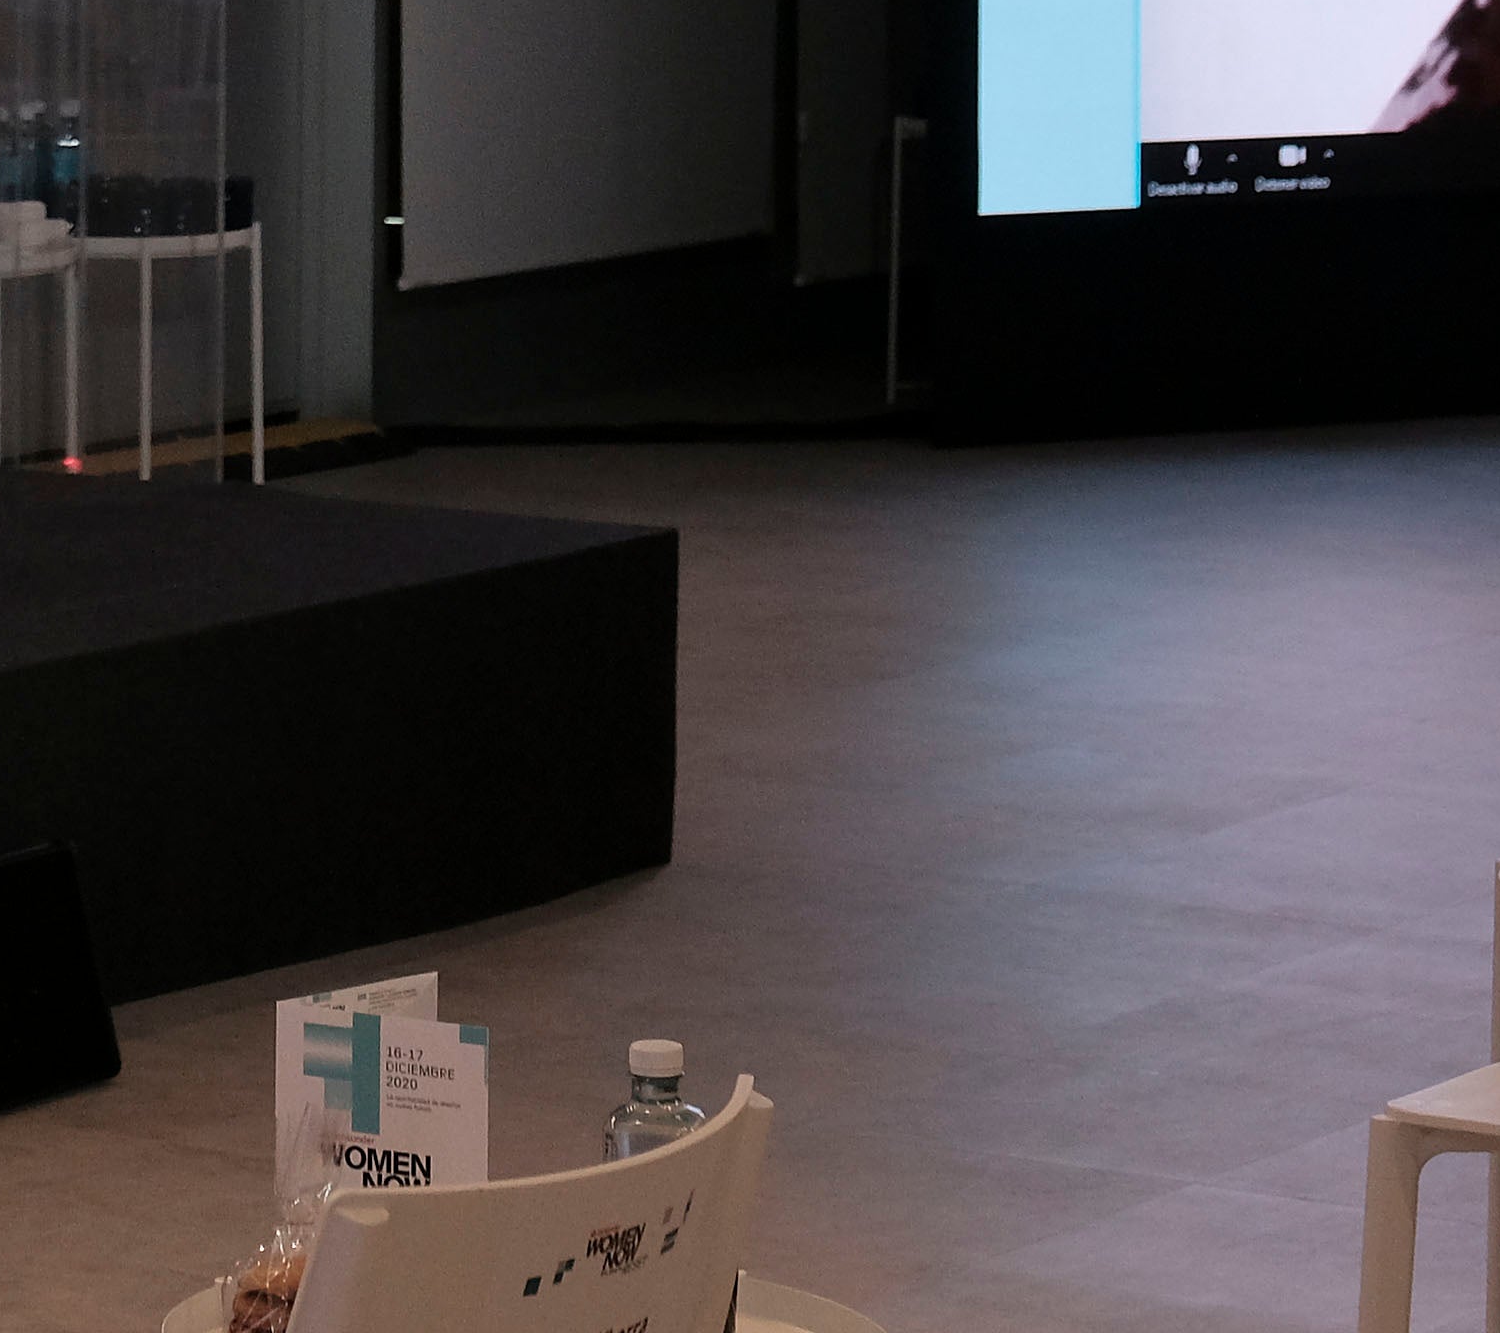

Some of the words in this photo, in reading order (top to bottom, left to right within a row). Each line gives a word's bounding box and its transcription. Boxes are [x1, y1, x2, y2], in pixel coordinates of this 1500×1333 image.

[386, 1046, 424, 1062] 16-17
[385, 1062, 455, 1081] DICIEMBRE
[386, 1077, 419, 1091] 2020
[586, 1223, 647, 1259] WOMEN
